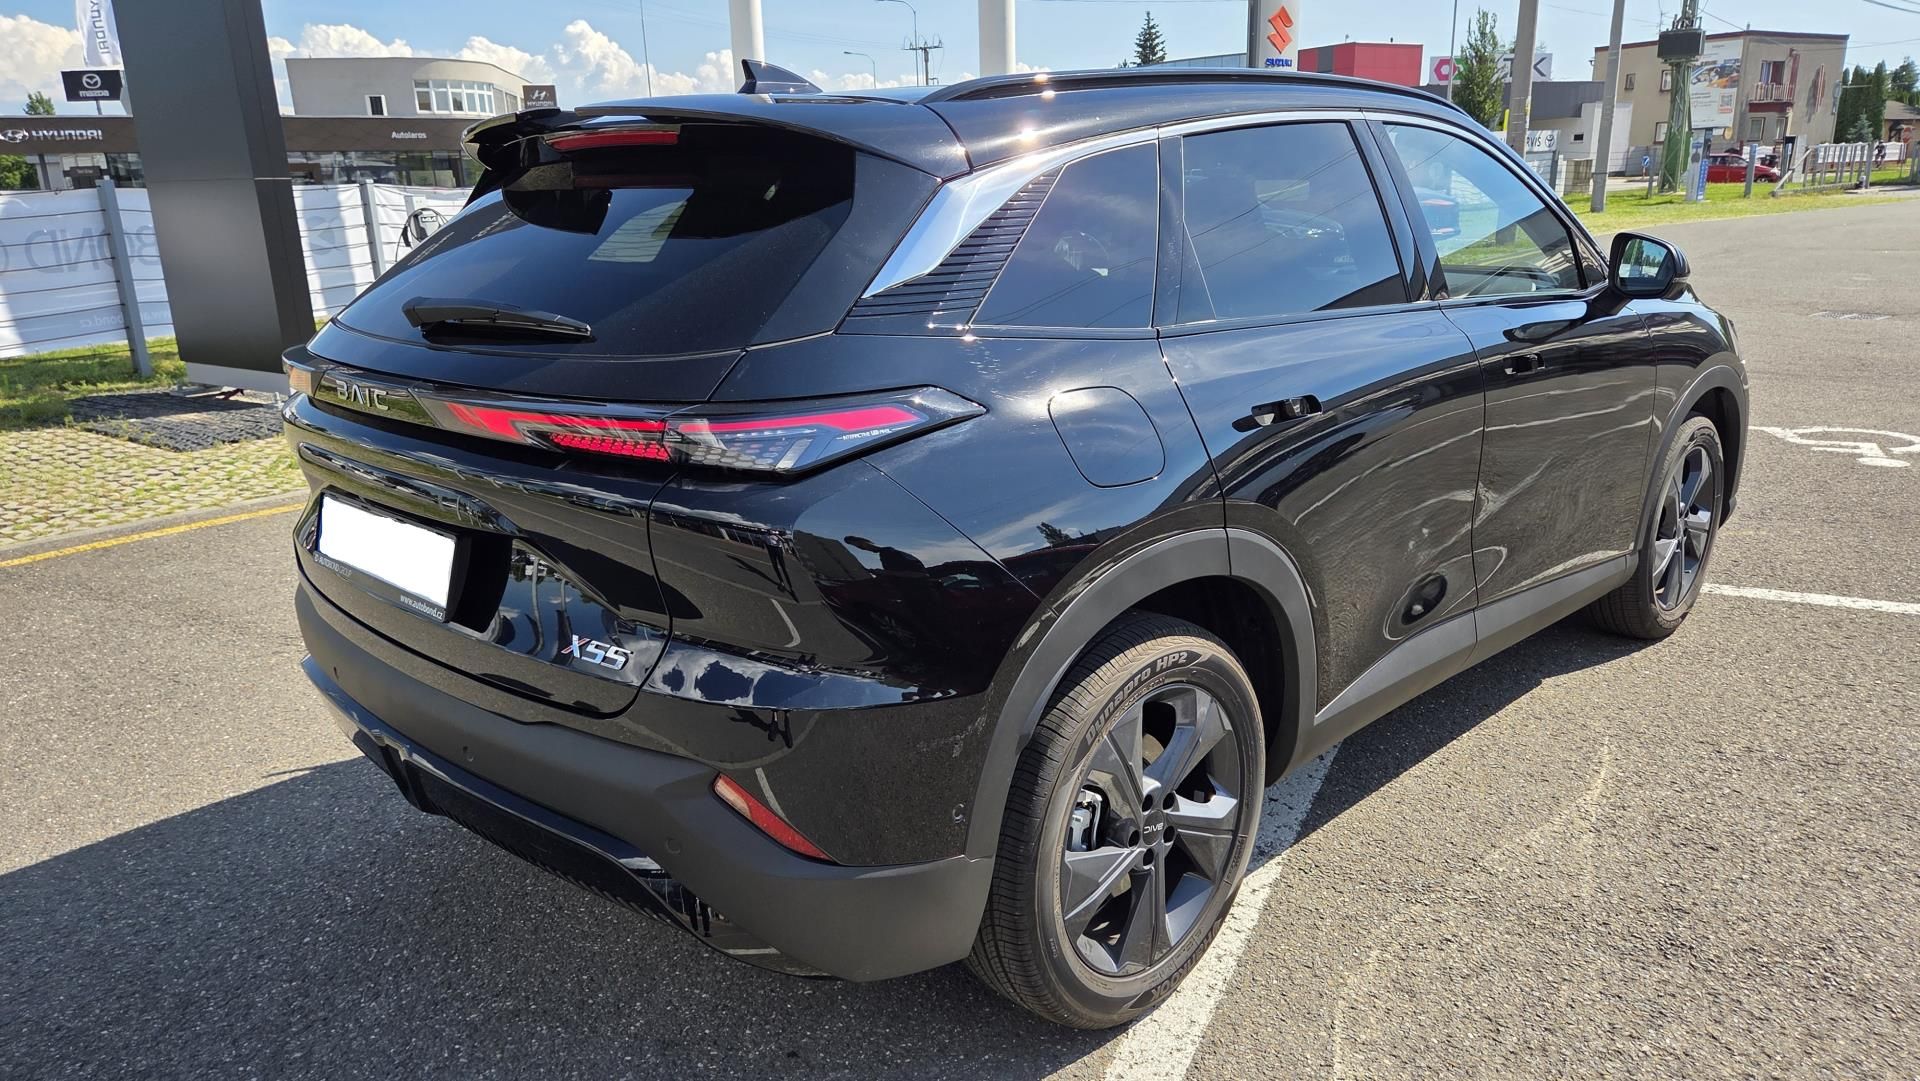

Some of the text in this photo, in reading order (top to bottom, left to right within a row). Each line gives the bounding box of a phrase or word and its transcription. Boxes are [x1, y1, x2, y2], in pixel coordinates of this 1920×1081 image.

[1265, 58, 1292, 67] SUZUKI
[31, 129, 103, 141] HYUNDAI
[391, 131, 427, 139] Autolaros
[336, 380, 389, 411] BAIC
[400, 594, 443, 620] www.autobond.cz
[561, 634, 634, 671] X55
[1156, 652, 1188, 672] HP2
